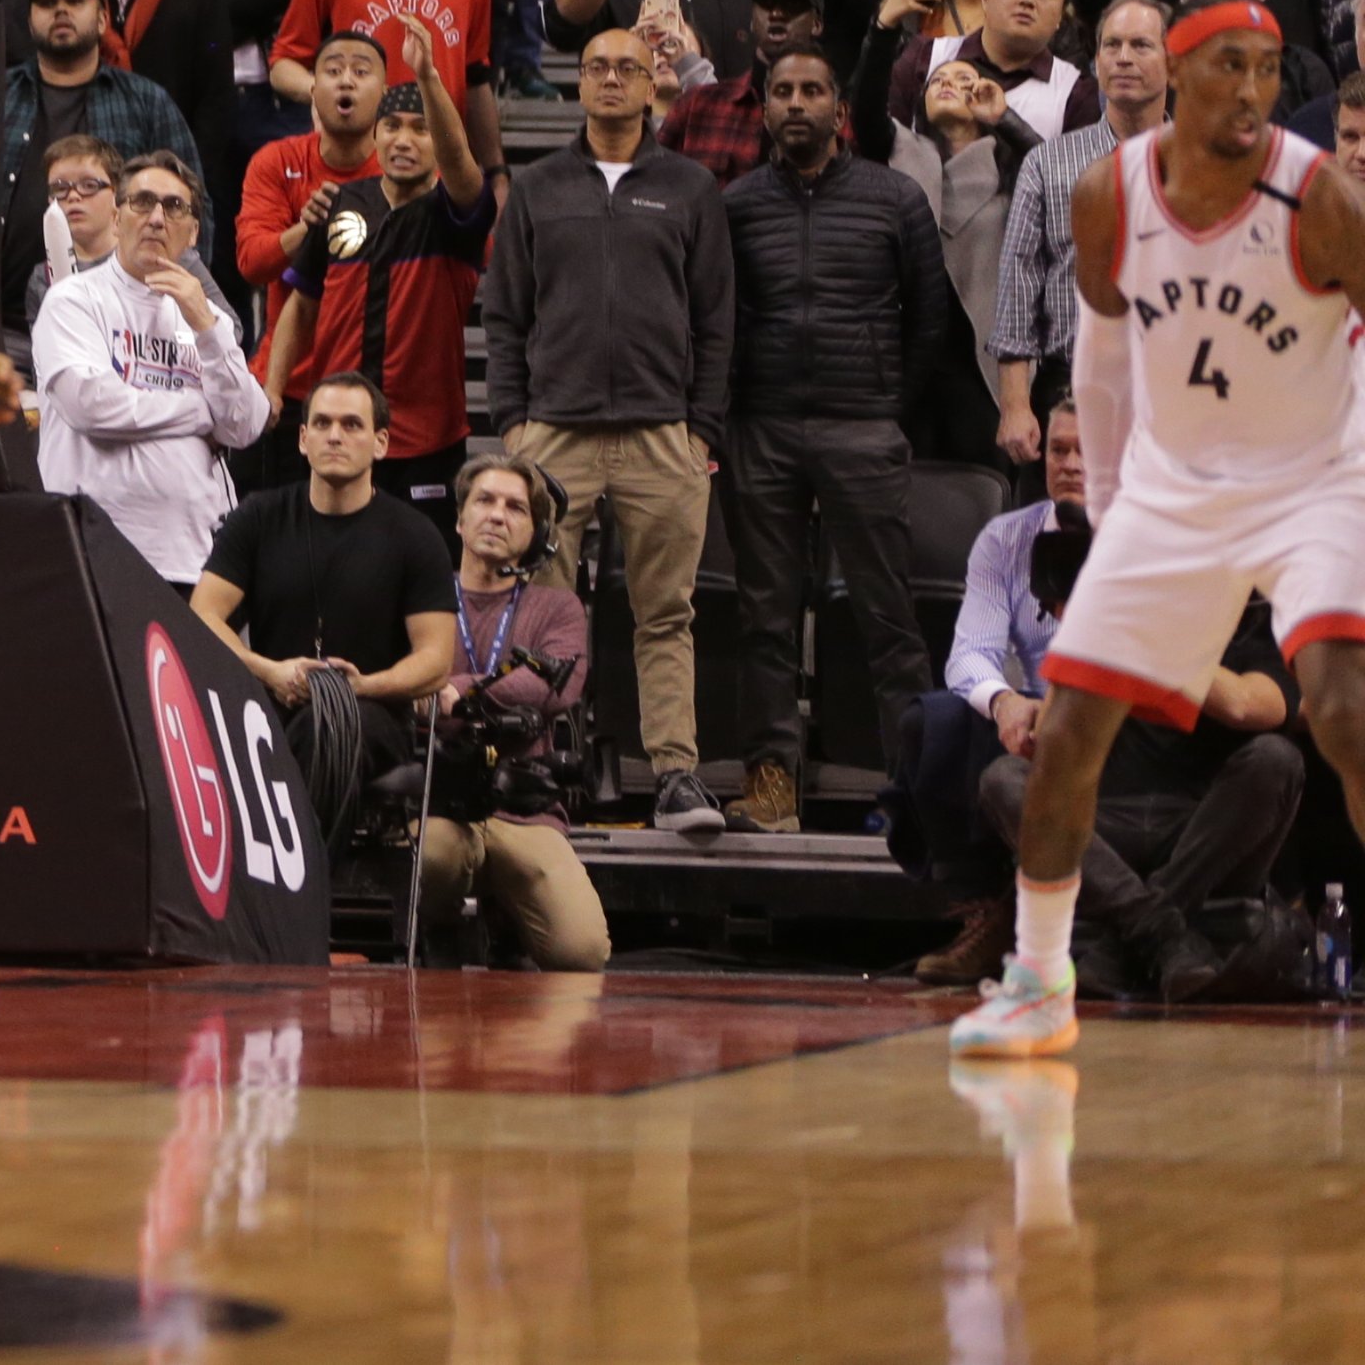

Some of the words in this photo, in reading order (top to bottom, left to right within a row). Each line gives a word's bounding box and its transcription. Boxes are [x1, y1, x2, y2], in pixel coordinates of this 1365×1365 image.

[1134, 277, 1299, 355] APTORS
[1187, 338, 1231, 401] 4
[207, 689, 306, 893] LG
